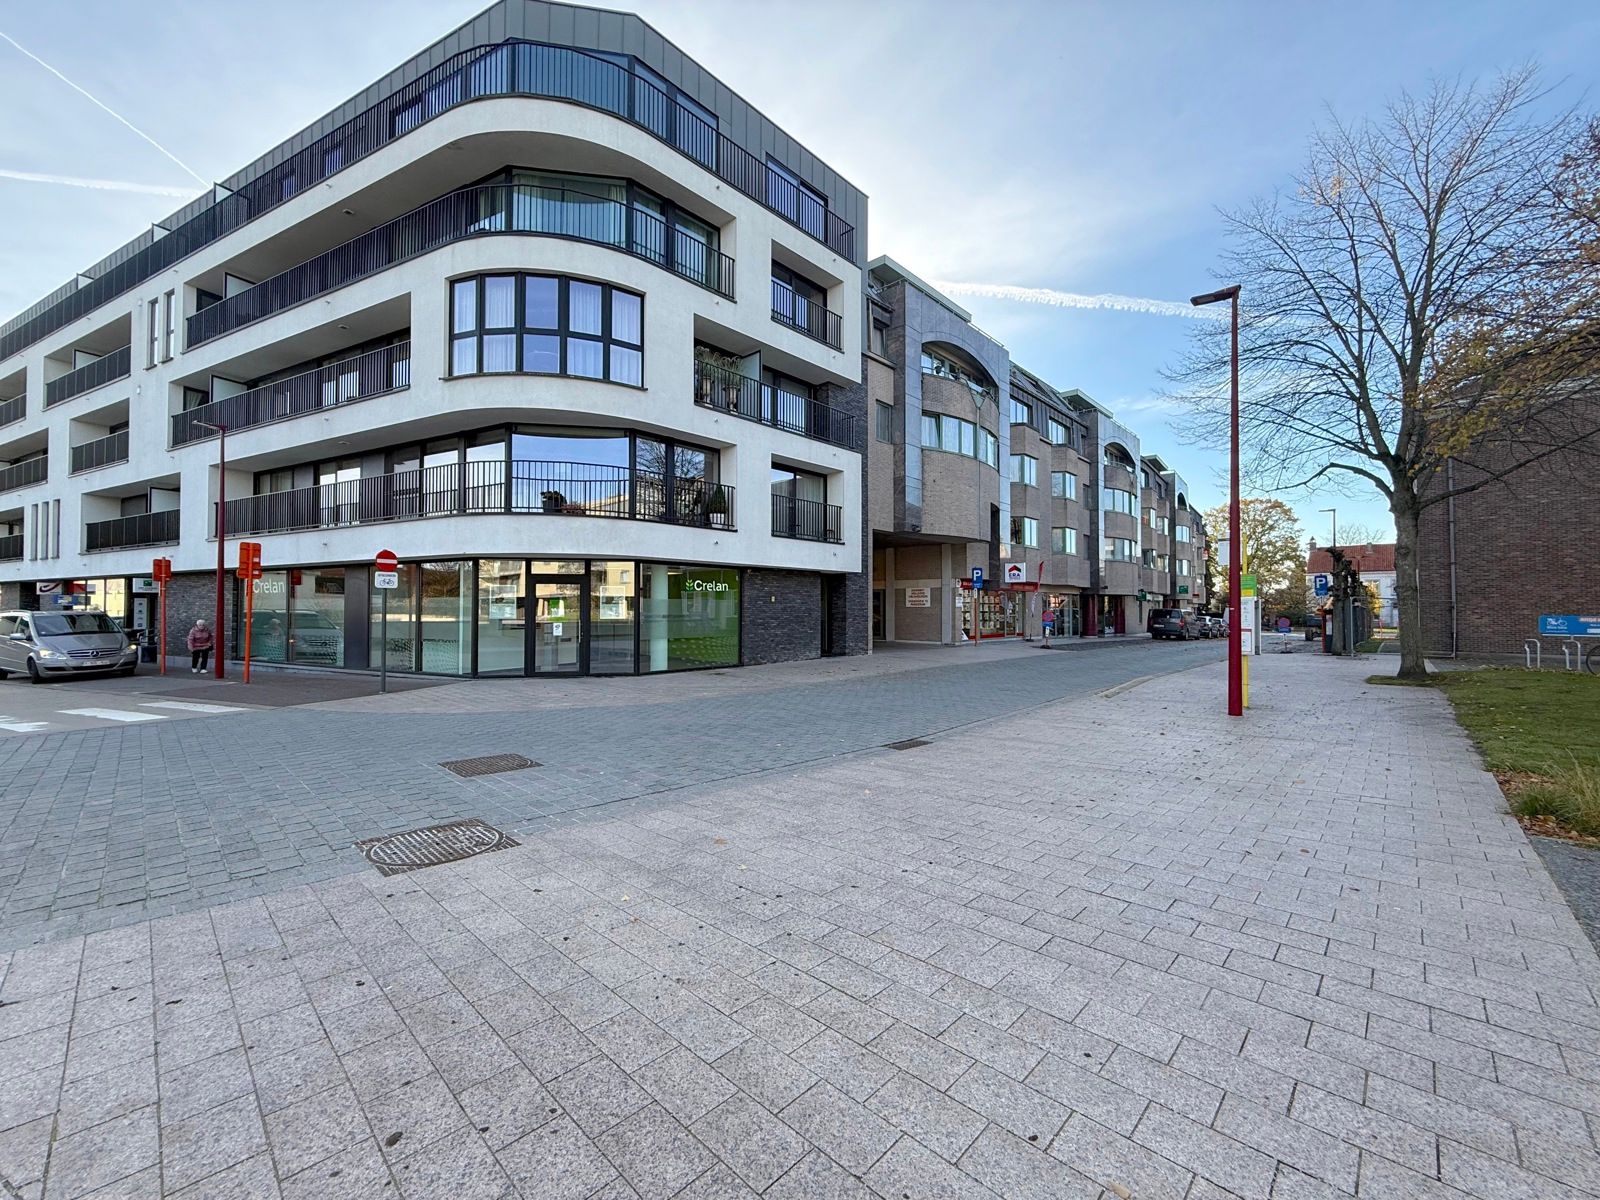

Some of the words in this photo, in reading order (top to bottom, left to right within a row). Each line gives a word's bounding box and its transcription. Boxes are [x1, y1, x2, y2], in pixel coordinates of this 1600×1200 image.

[973, 569, 982, 582] P
[252, 578, 285, 593] Crelan
[694, 579, 729, 592] Crelan
[1316, 577, 1326, 589] P
